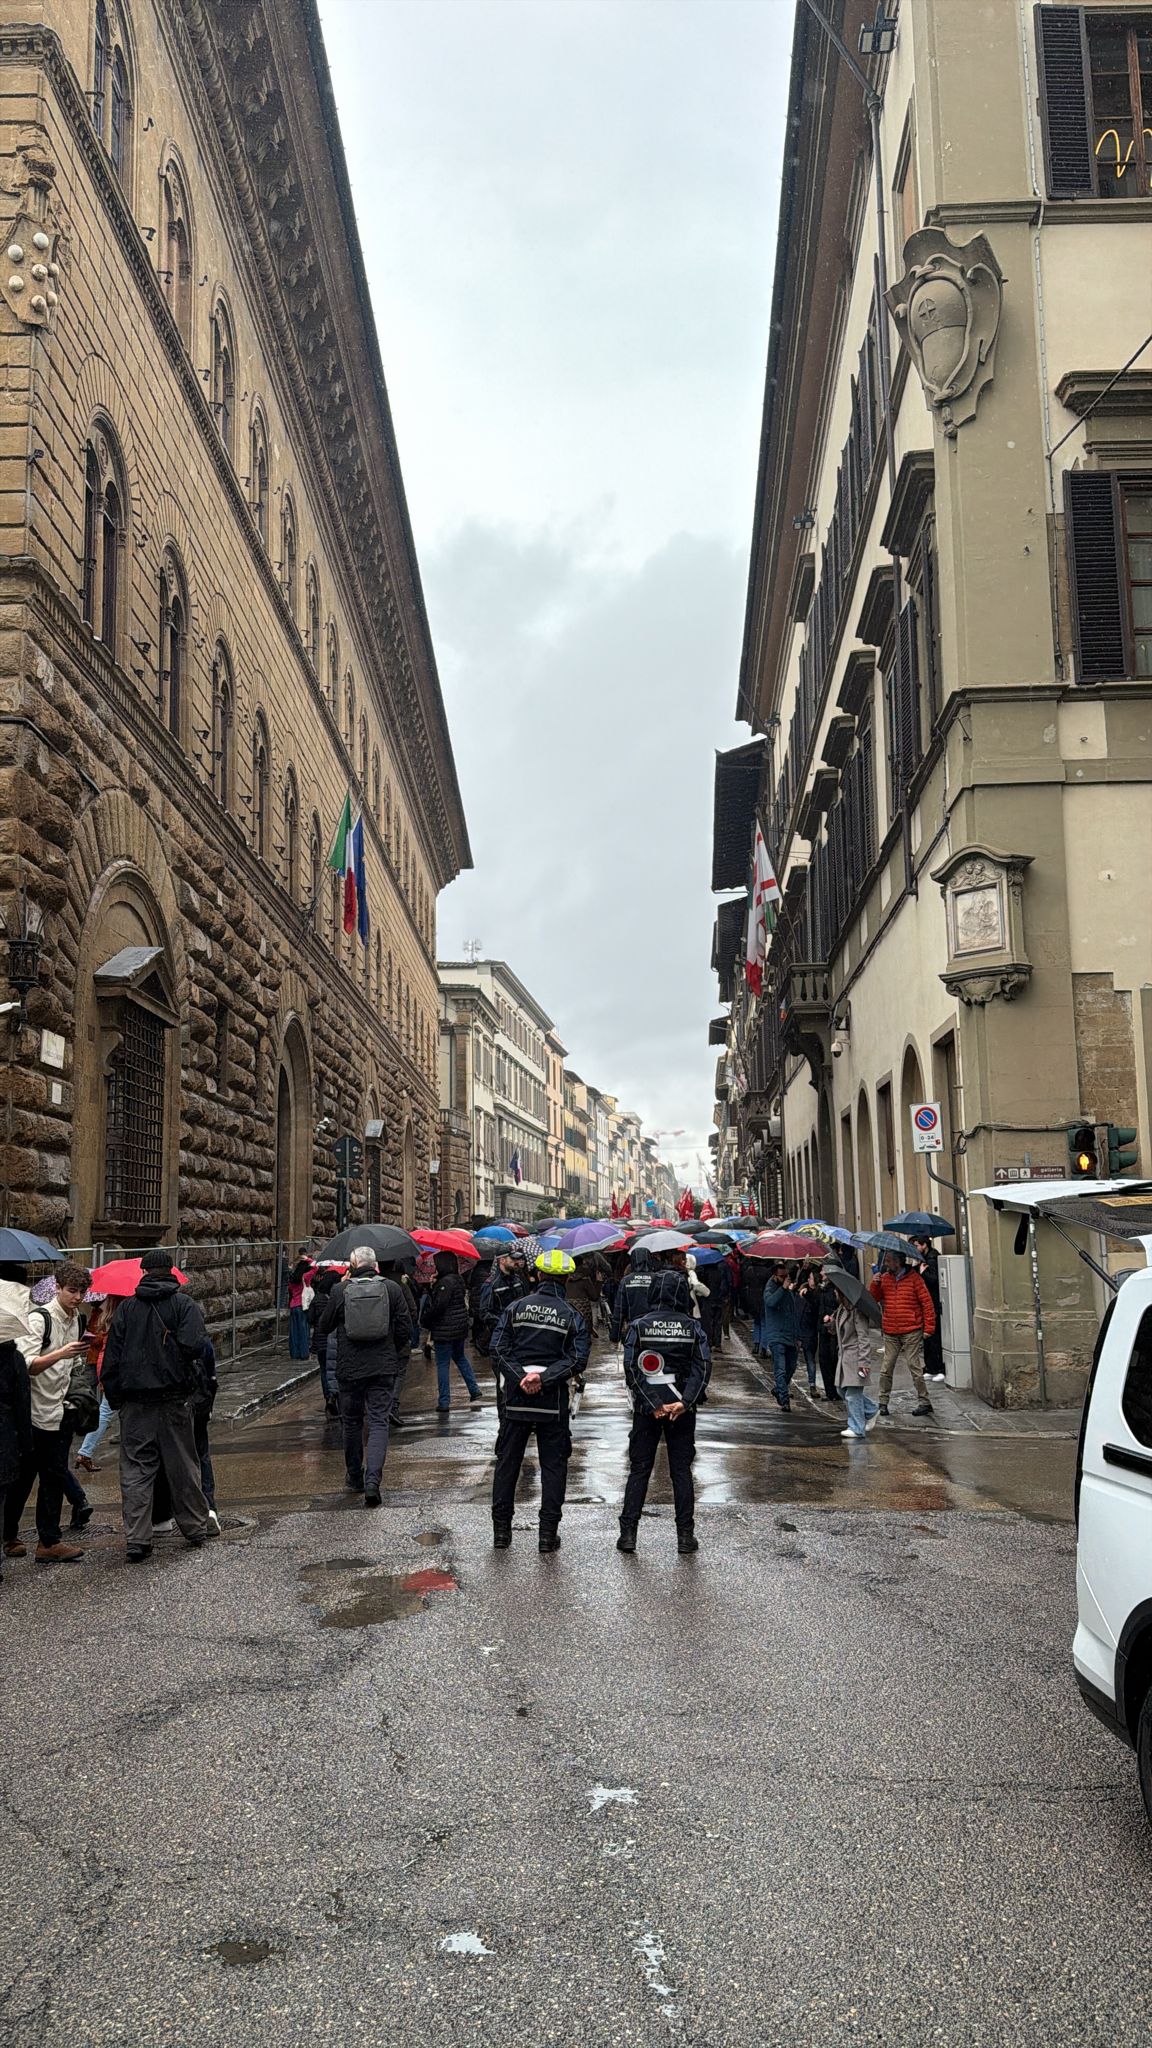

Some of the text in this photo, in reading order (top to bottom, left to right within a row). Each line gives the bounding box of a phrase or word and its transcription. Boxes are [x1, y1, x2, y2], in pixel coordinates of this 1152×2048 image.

[525, 1304, 558, 1316] POLIZIA
[515, 1311, 566, 1326] MUNICIPALE
[652, 1320, 682, 1328] POLIZIA
[644, 1328, 692, 1337] MUNICIPALE
